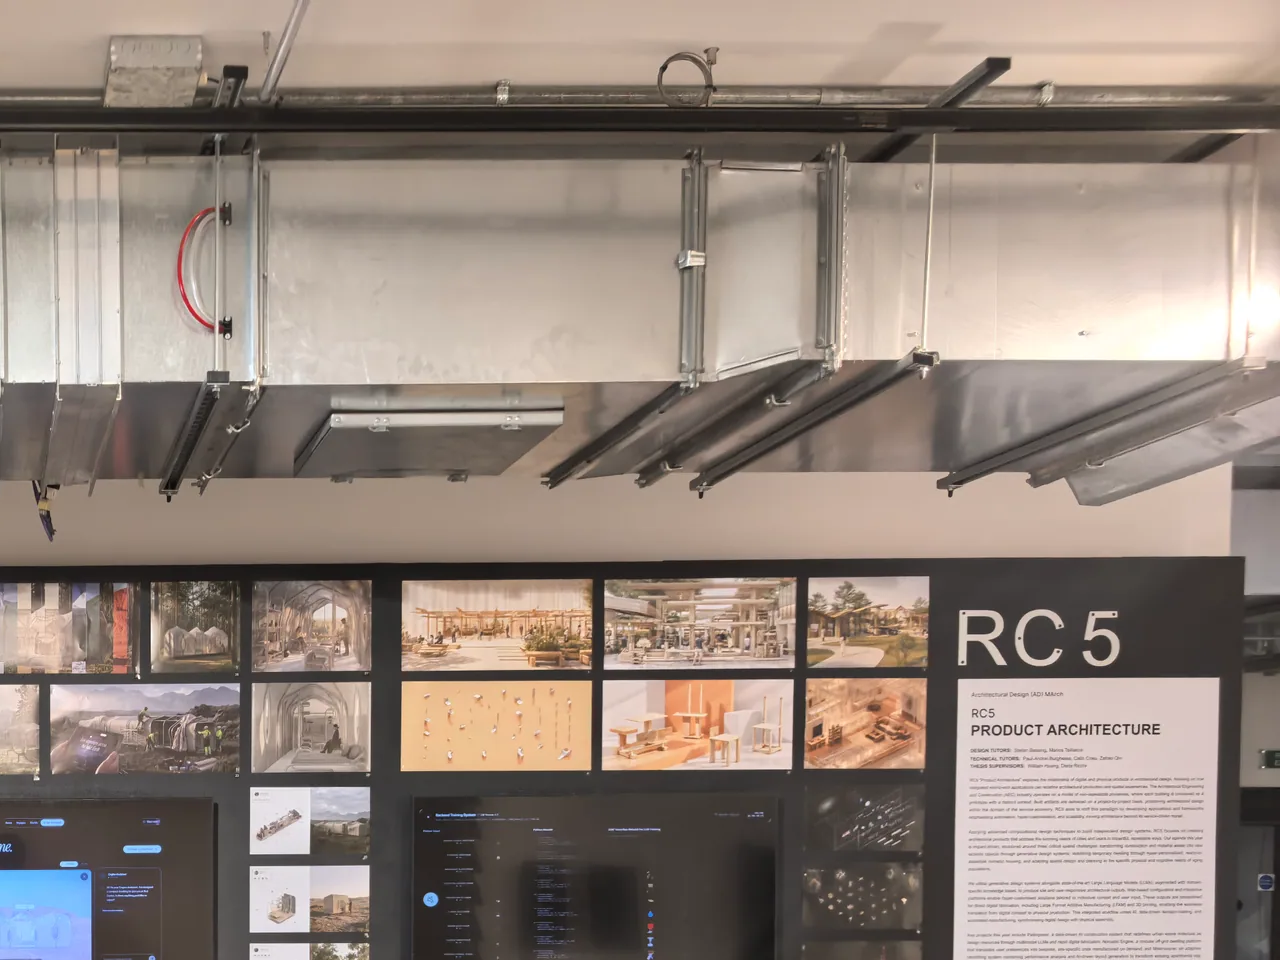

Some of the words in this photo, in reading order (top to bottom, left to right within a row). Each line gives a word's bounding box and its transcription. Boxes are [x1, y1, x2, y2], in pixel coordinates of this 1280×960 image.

[957, 608, 1064, 667] RC
[1082, 610, 1121, 667] 5
[971, 708, 996, 718] RC5
[971, 724, 1044, 736] PRODUCT
[1046, 724, 1161, 736] ARCHITECTURE
